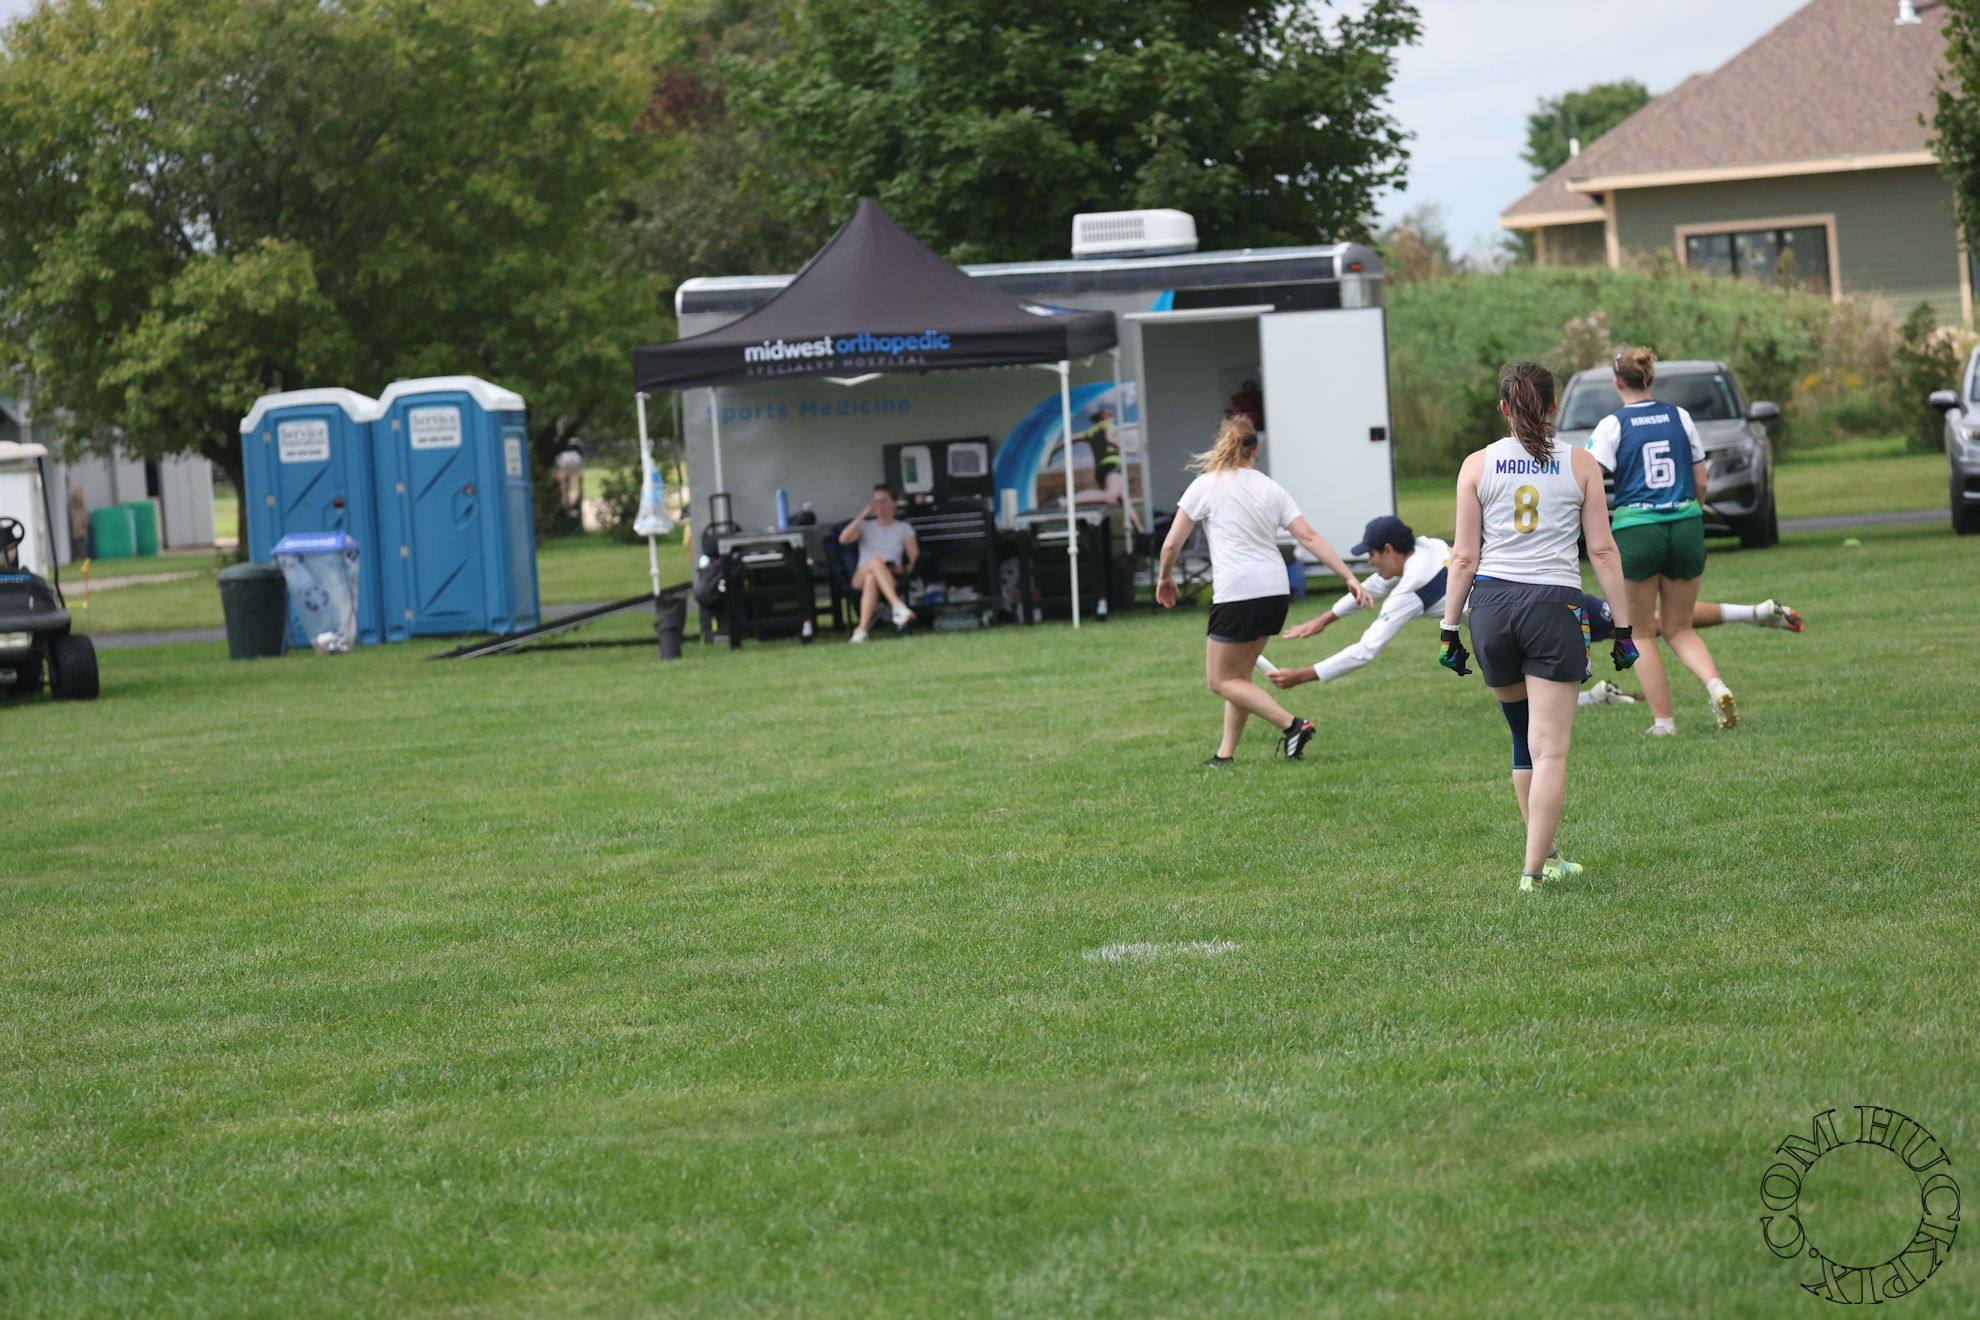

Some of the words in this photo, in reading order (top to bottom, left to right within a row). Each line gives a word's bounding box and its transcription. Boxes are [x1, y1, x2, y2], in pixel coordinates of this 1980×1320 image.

[744, 336, 834, 362] midwest
[835, 330, 951, 355] orthopedic
[800, 398, 911, 418] Medicine
[1496, 459, 1560, 475] MADISON
[1642, 440, 1676, 489] 6
[1514, 484, 1539, 534] 8
